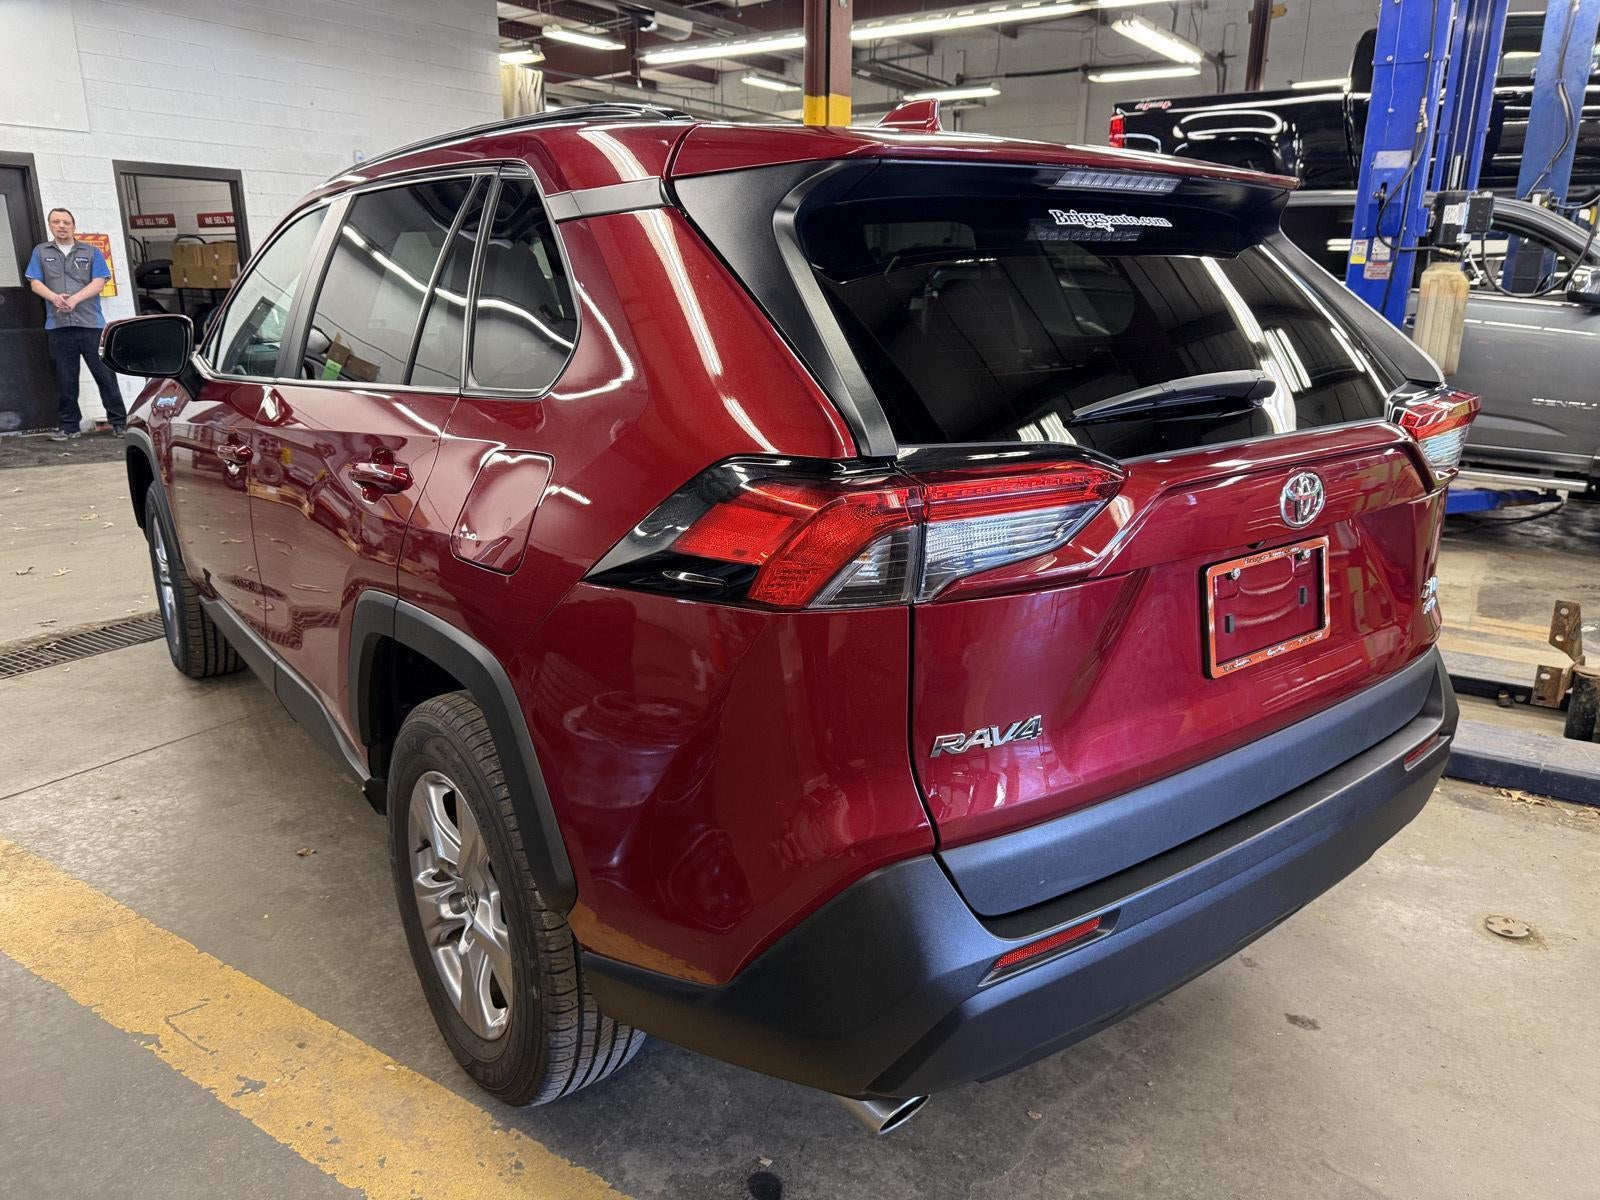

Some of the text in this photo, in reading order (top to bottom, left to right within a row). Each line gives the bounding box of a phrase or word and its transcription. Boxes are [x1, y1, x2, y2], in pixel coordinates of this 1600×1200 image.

[136, 218, 144, 226] WE
[155, 217, 168, 225] TIRES
[213, 216, 225, 224] SELL
[929, 714, 1043, 759] RAV4
